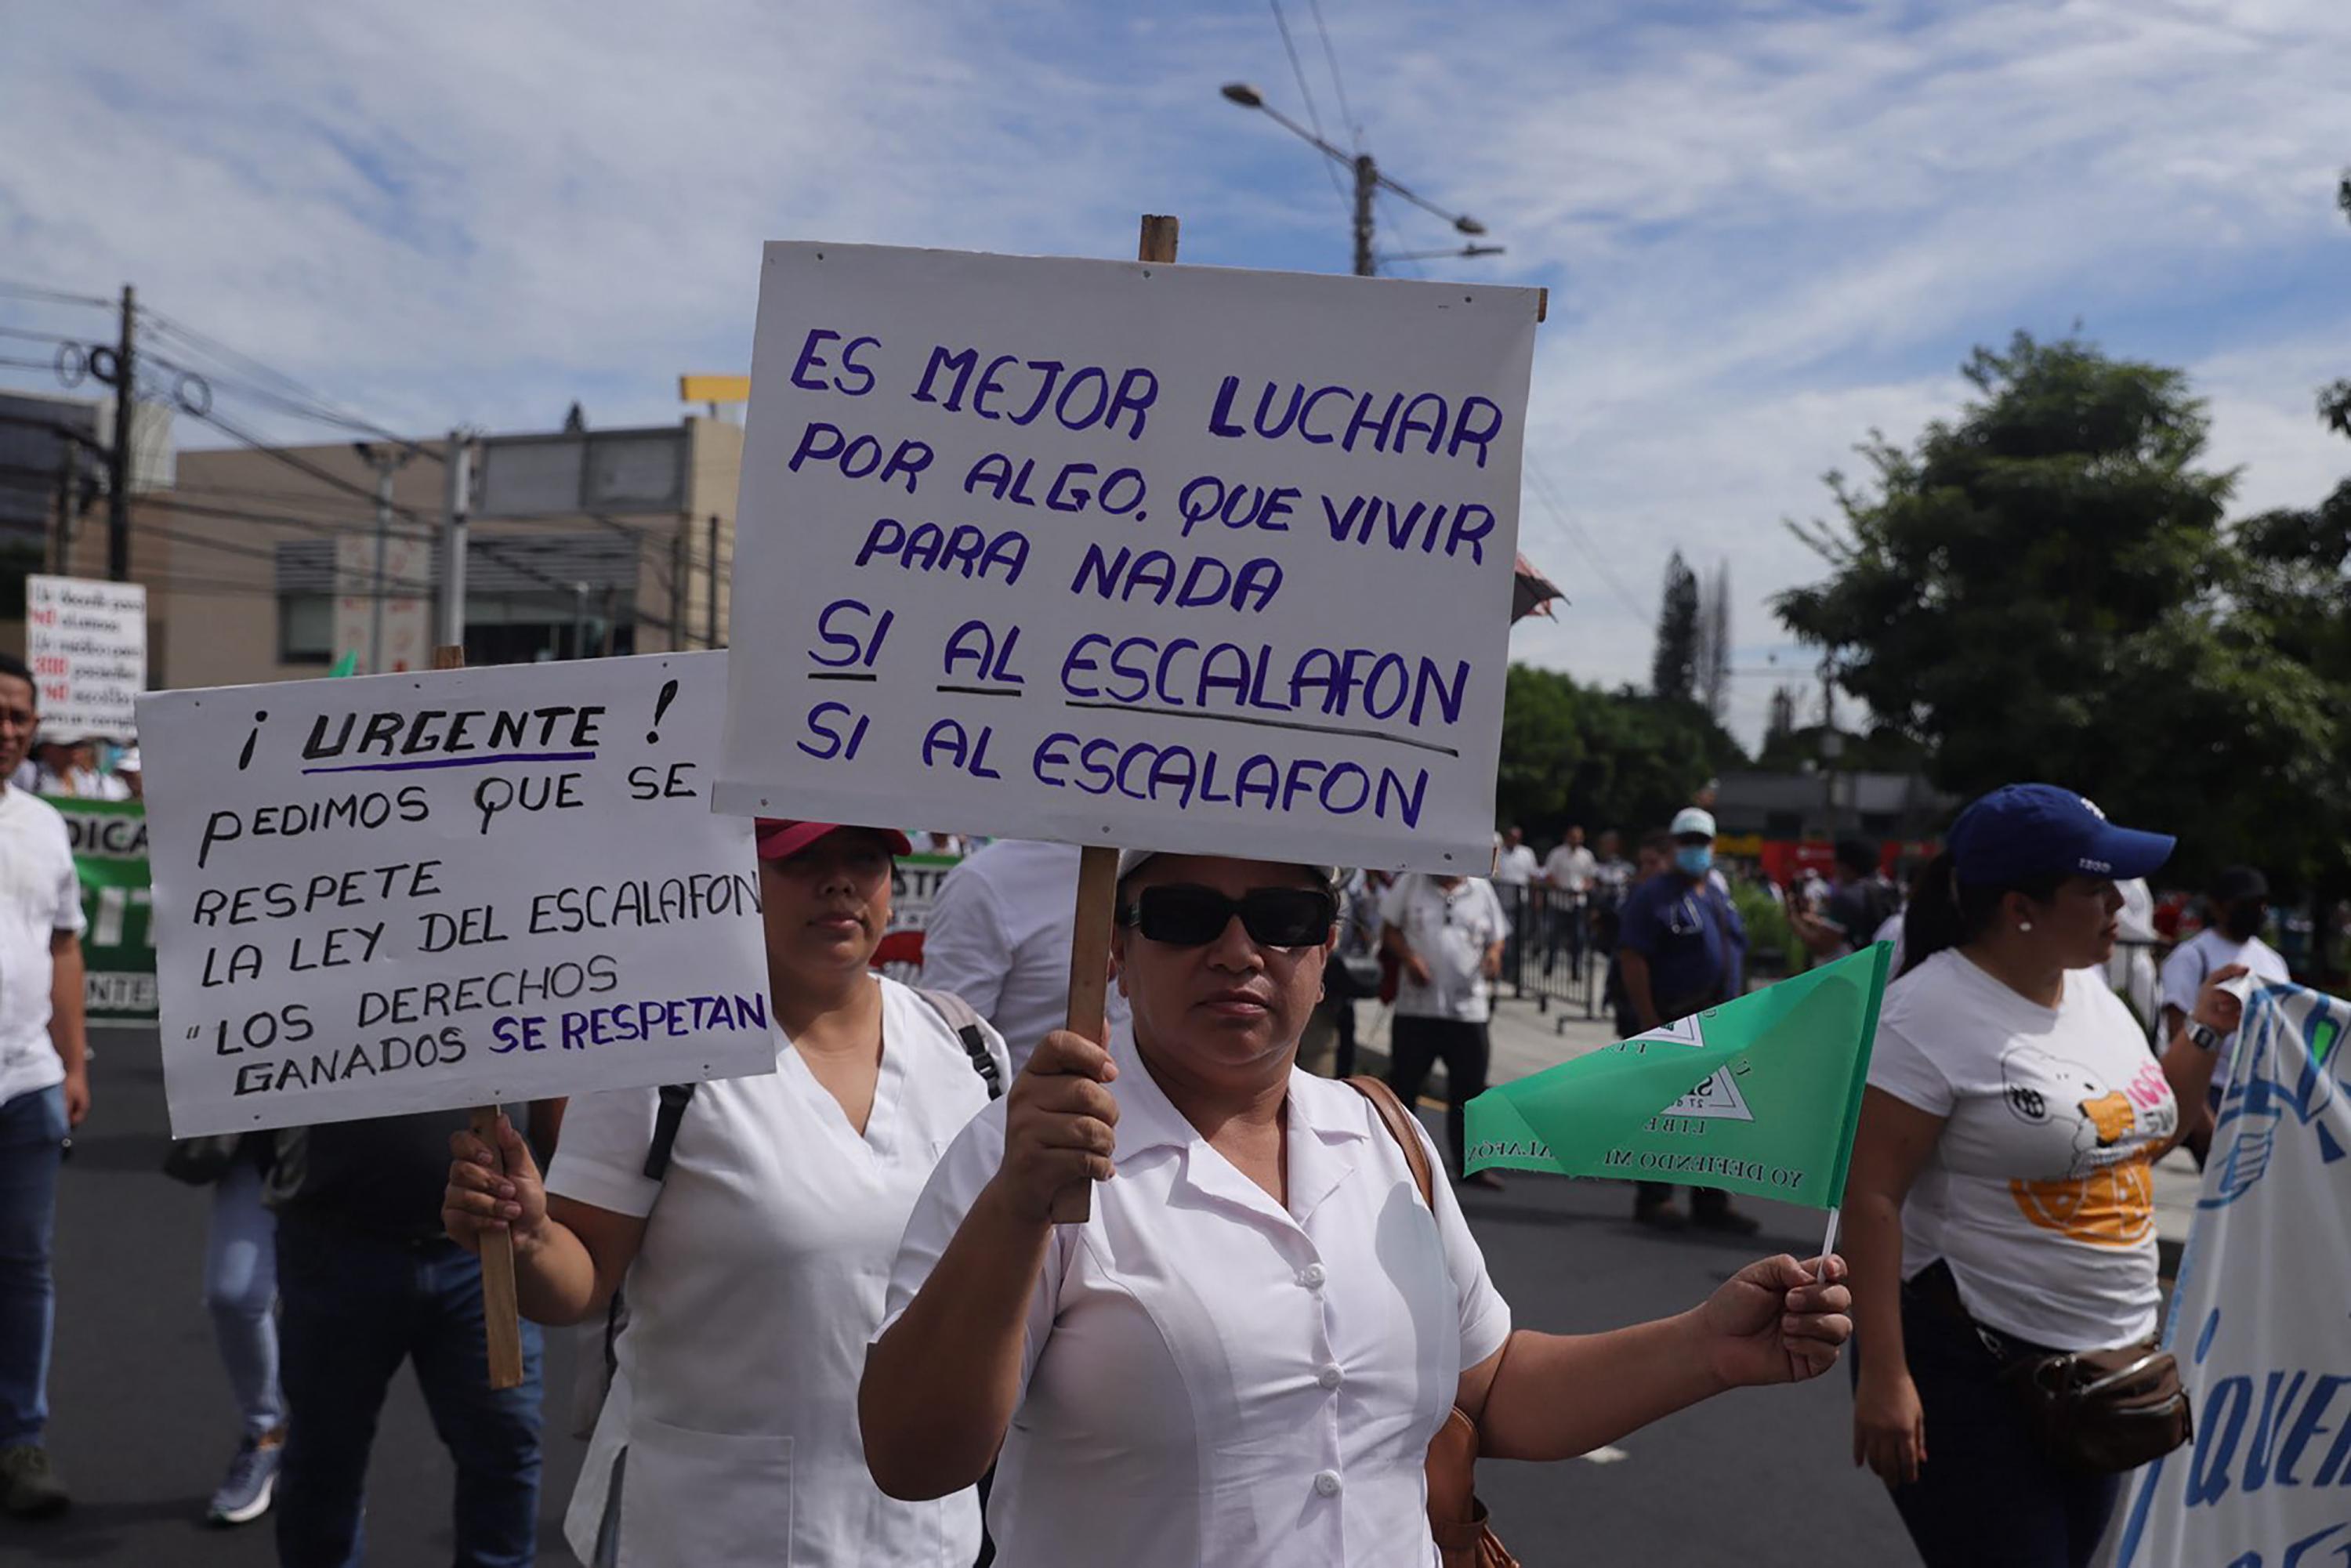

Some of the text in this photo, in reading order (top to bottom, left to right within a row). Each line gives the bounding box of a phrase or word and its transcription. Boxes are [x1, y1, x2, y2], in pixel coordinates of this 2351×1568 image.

[790, 328, 1502, 469] ES MEJOR LUCHAR
[788, 422, 934, 494] POR
[1179, 476, 1302, 538] QUE
[1321, 494, 1495, 566] VIVIR
[854, 518, 1283, 613] PARA NADA
[808, 599, 1470, 726] SI AL ESCALAFON
[302, 706, 606, 759] URGENTE
[796, 701, 1429, 828] SI AL ESCALAFON
[474, 773, 583, 835] QUE
[628, 763, 697, 799] SE
[193, 860, 442, 926] RESPETE
[201, 871, 763, 987] LA LEY DEL ESCALAFON
[358, 954, 618, 1027] DERECHOS
[234, 993, 767, 1096] GANADOS SE RESPETAN
